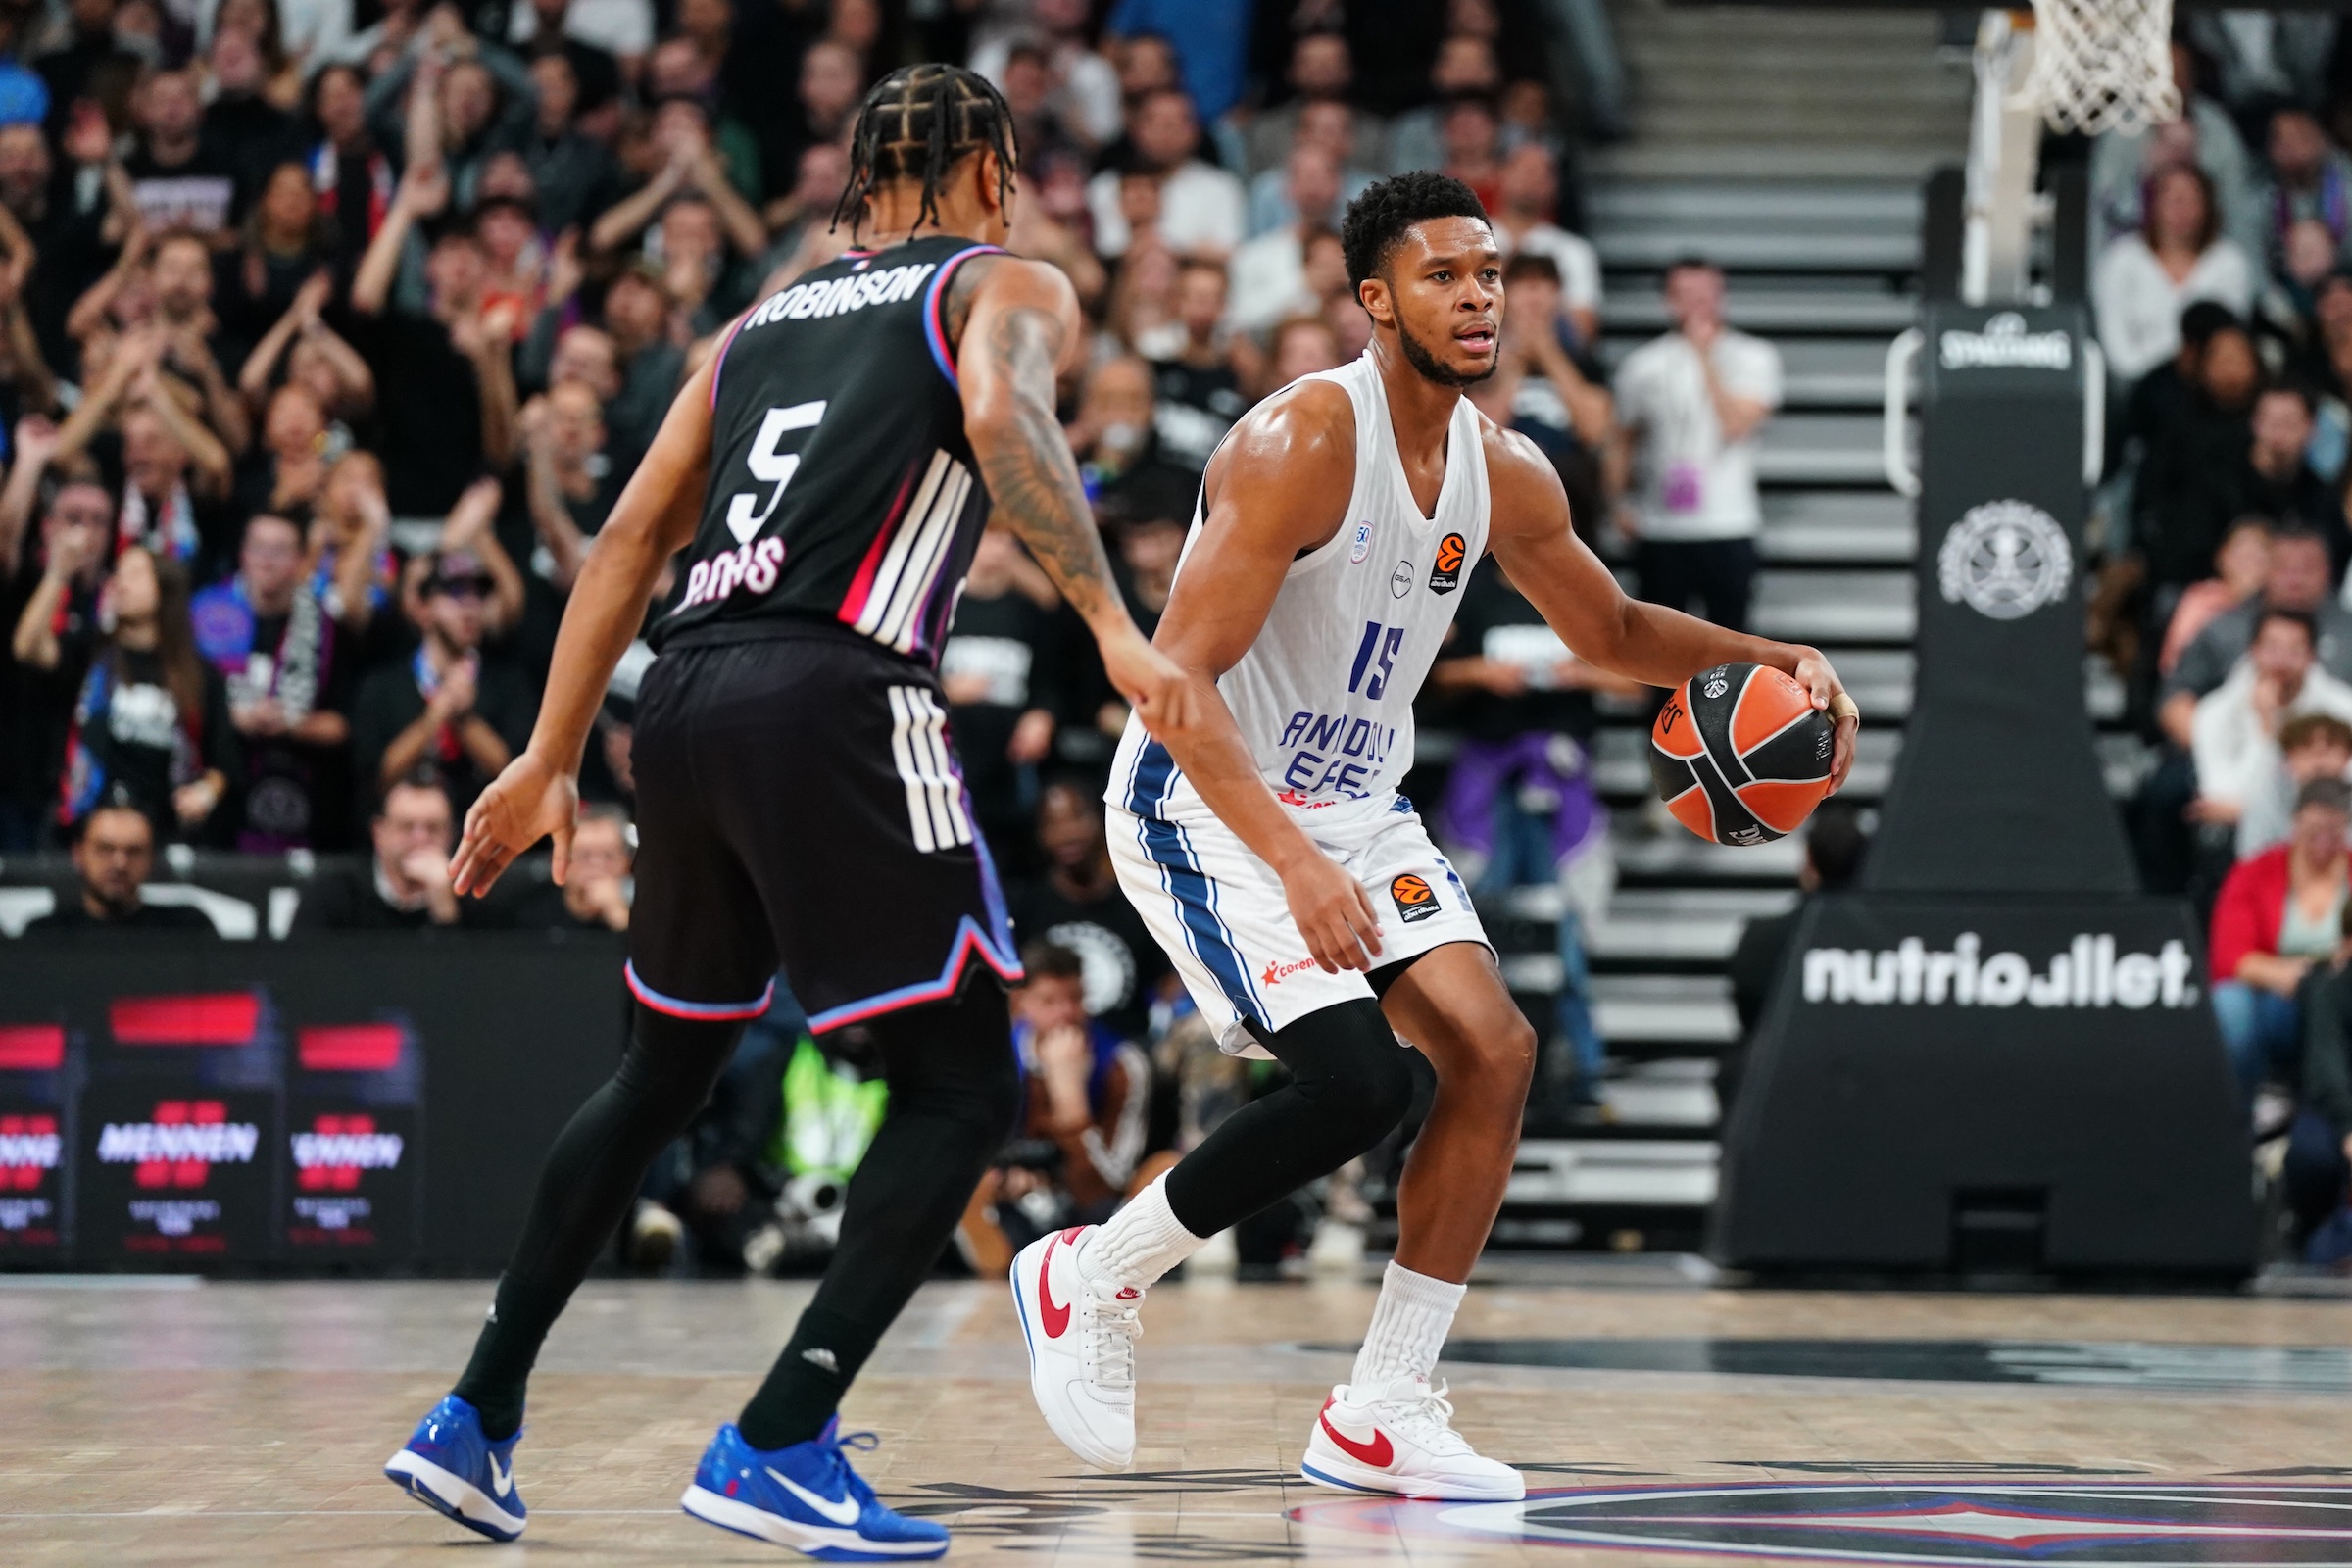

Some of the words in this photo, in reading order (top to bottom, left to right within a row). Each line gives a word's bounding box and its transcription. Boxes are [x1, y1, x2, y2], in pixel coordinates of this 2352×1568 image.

[743, 263, 936, 331] ROBINSON
[726, 400, 828, 544] 5
[1348, 621, 1404, 700] 15
[99, 1122, 259, 1163] MENNEN
